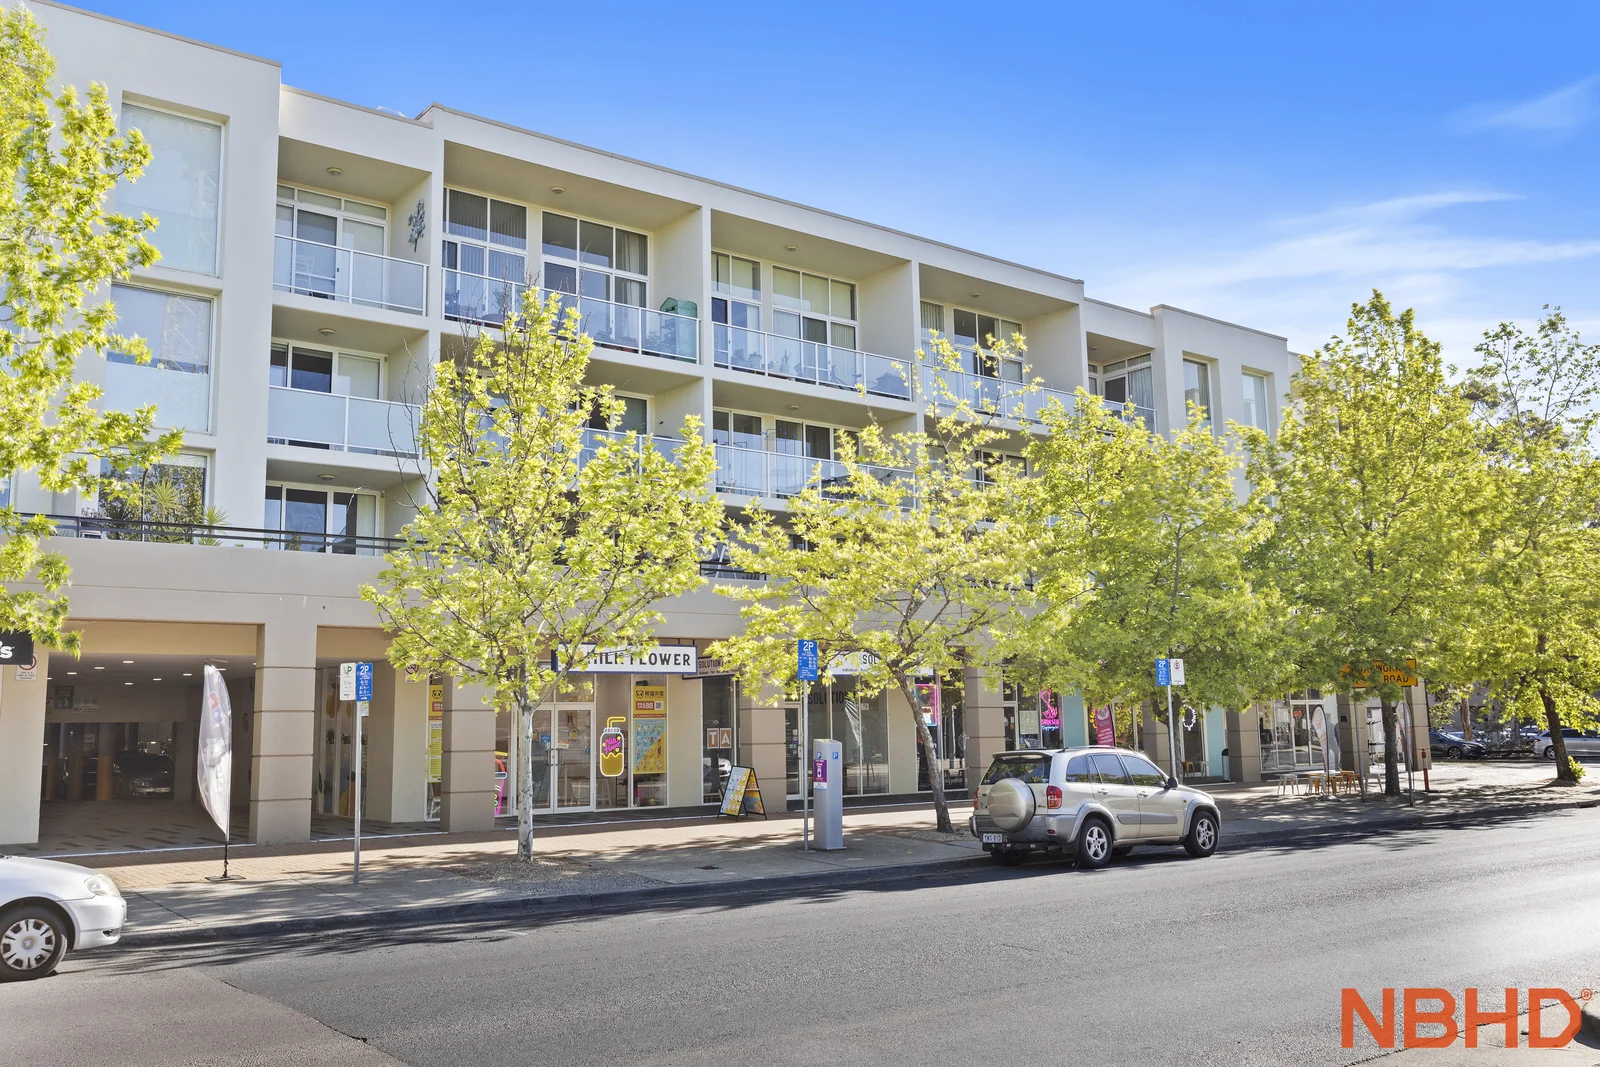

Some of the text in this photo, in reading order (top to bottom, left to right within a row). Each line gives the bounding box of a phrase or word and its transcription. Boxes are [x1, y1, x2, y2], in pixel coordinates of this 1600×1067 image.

[803, 641, 814, 651] 2P
[360, 666, 369, 675] 2P
[1383, 675, 1409, 683] ROAD
